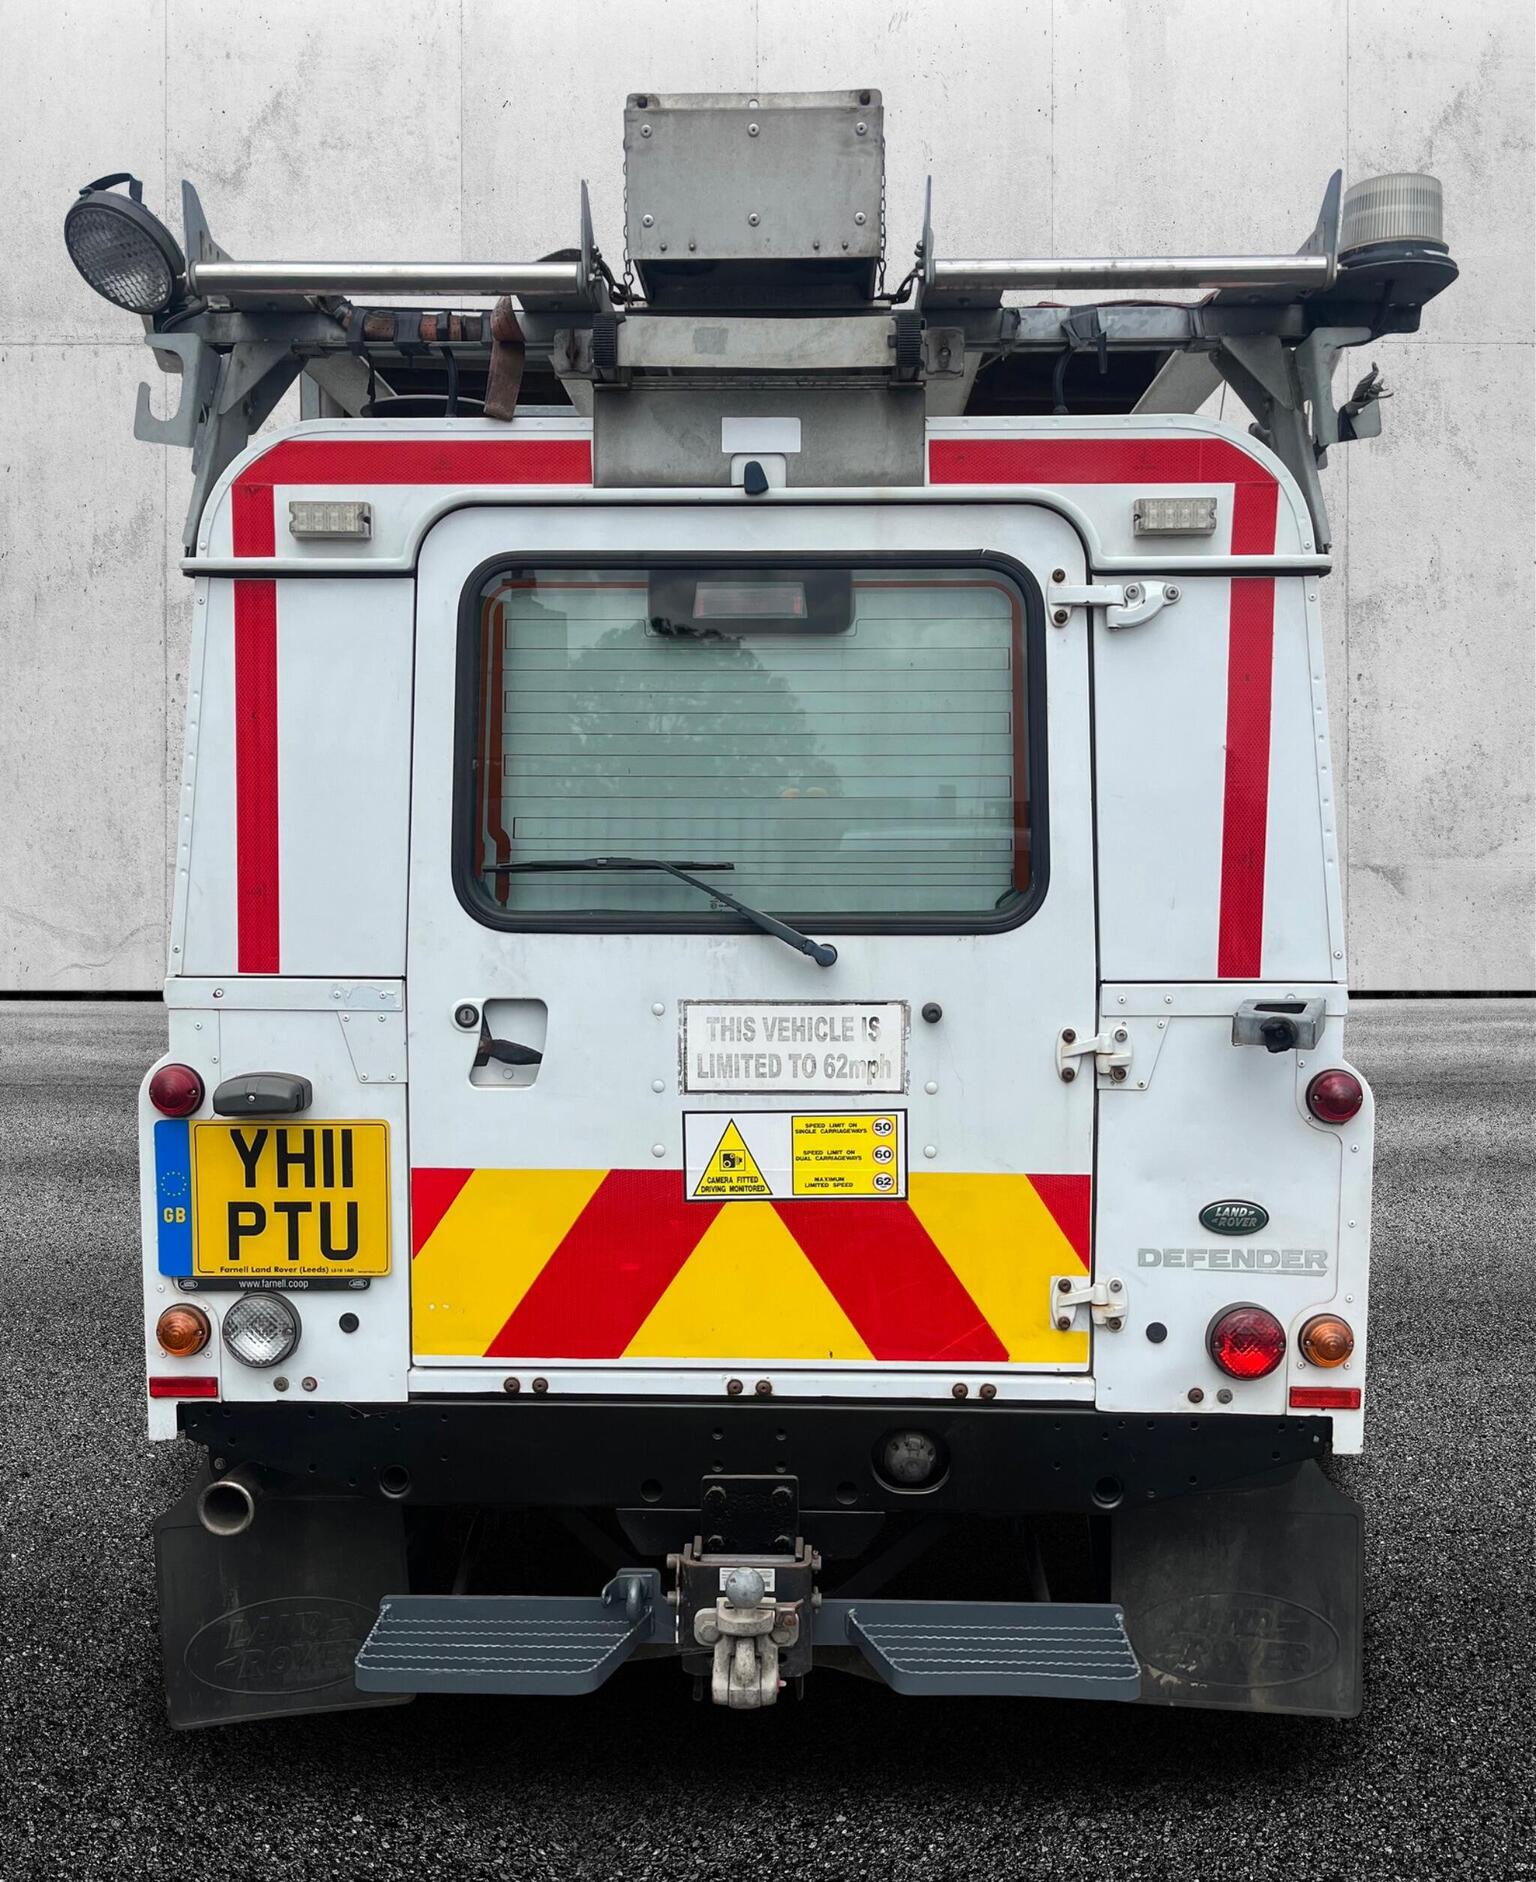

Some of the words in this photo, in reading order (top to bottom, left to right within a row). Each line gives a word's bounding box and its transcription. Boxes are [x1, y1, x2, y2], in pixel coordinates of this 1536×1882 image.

[706, 1016, 757, 1042] THIS
[762, 1016, 855, 1042] VEHICLE
[861, 1016, 882, 1042] IS
[697, 1053, 782, 1079] LIMITED
[788, 1053, 817, 1079] TO
[823, 1053, 892, 1086] 62mph
[874, 1122, 891, 1132] 50
[874, 1149, 892, 1159] 60
[707, 1176, 733, 1184] CAMERA
[736, 1175, 759, 1183] FITTED
[875, 1176, 892, 1186] 62
[701, 1185, 726, 1193] DRIVING
[729, 1184, 766, 1193] MONITORED
[163, 1207, 186, 1223] GB
[1215, 1207, 1247, 1217] LAND
[1218, 1217, 1258, 1227] ROVER
[227, 1201, 359, 1261] PTU
[1137, 1248, 1328, 1269] DEFENDER
[220, 1265, 249, 1273] Farnell
[251, 1265, 272, 1273] Land
[274, 1265, 297, 1273] Rover
[300, 1265, 329, 1274] (Leeds)
[239, 1279, 309, 1290] www.farnell.coop
